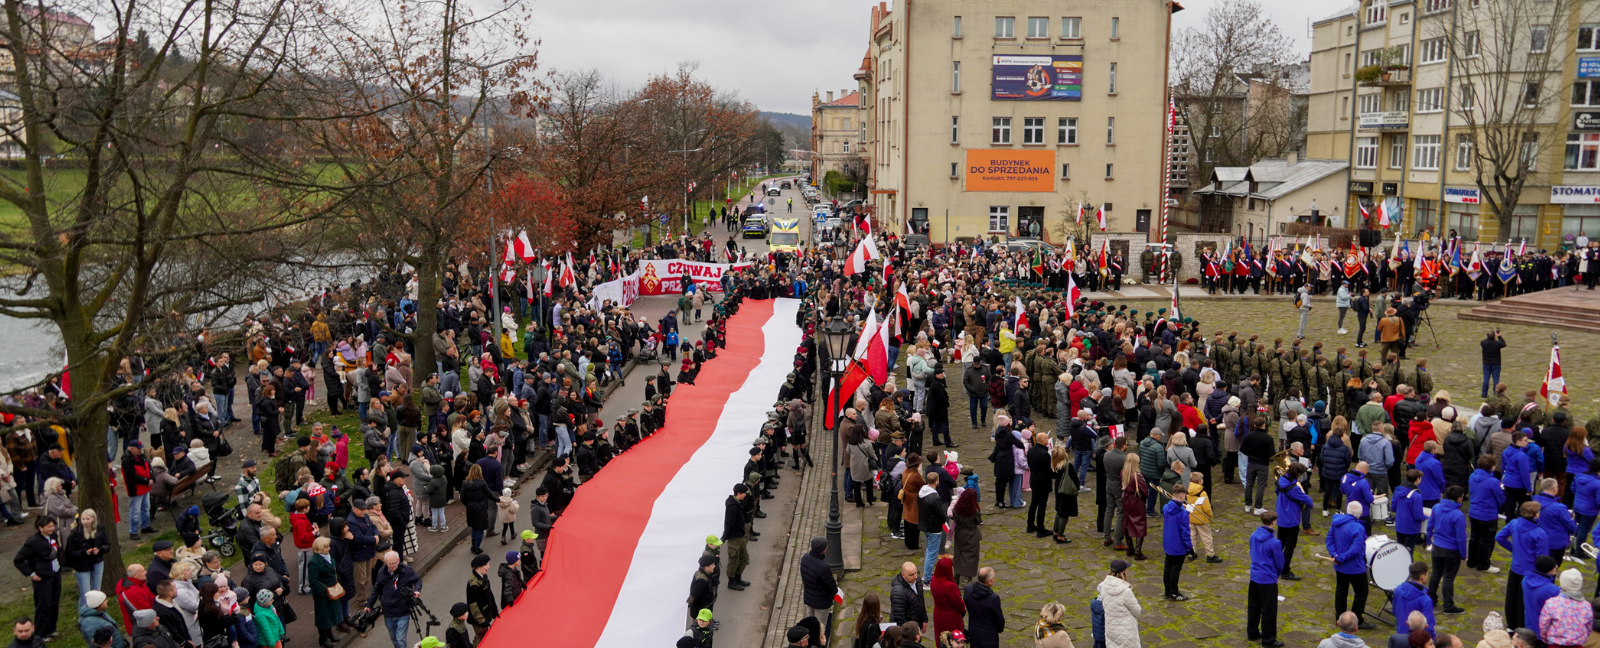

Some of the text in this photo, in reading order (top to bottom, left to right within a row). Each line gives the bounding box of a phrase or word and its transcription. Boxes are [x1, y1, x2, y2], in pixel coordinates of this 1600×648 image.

[1445, 188, 1478, 197] STOMATOLOG
[668, 262, 722, 278] CZUWAJ
[1382, 546, 1398, 557] YAMAHA
